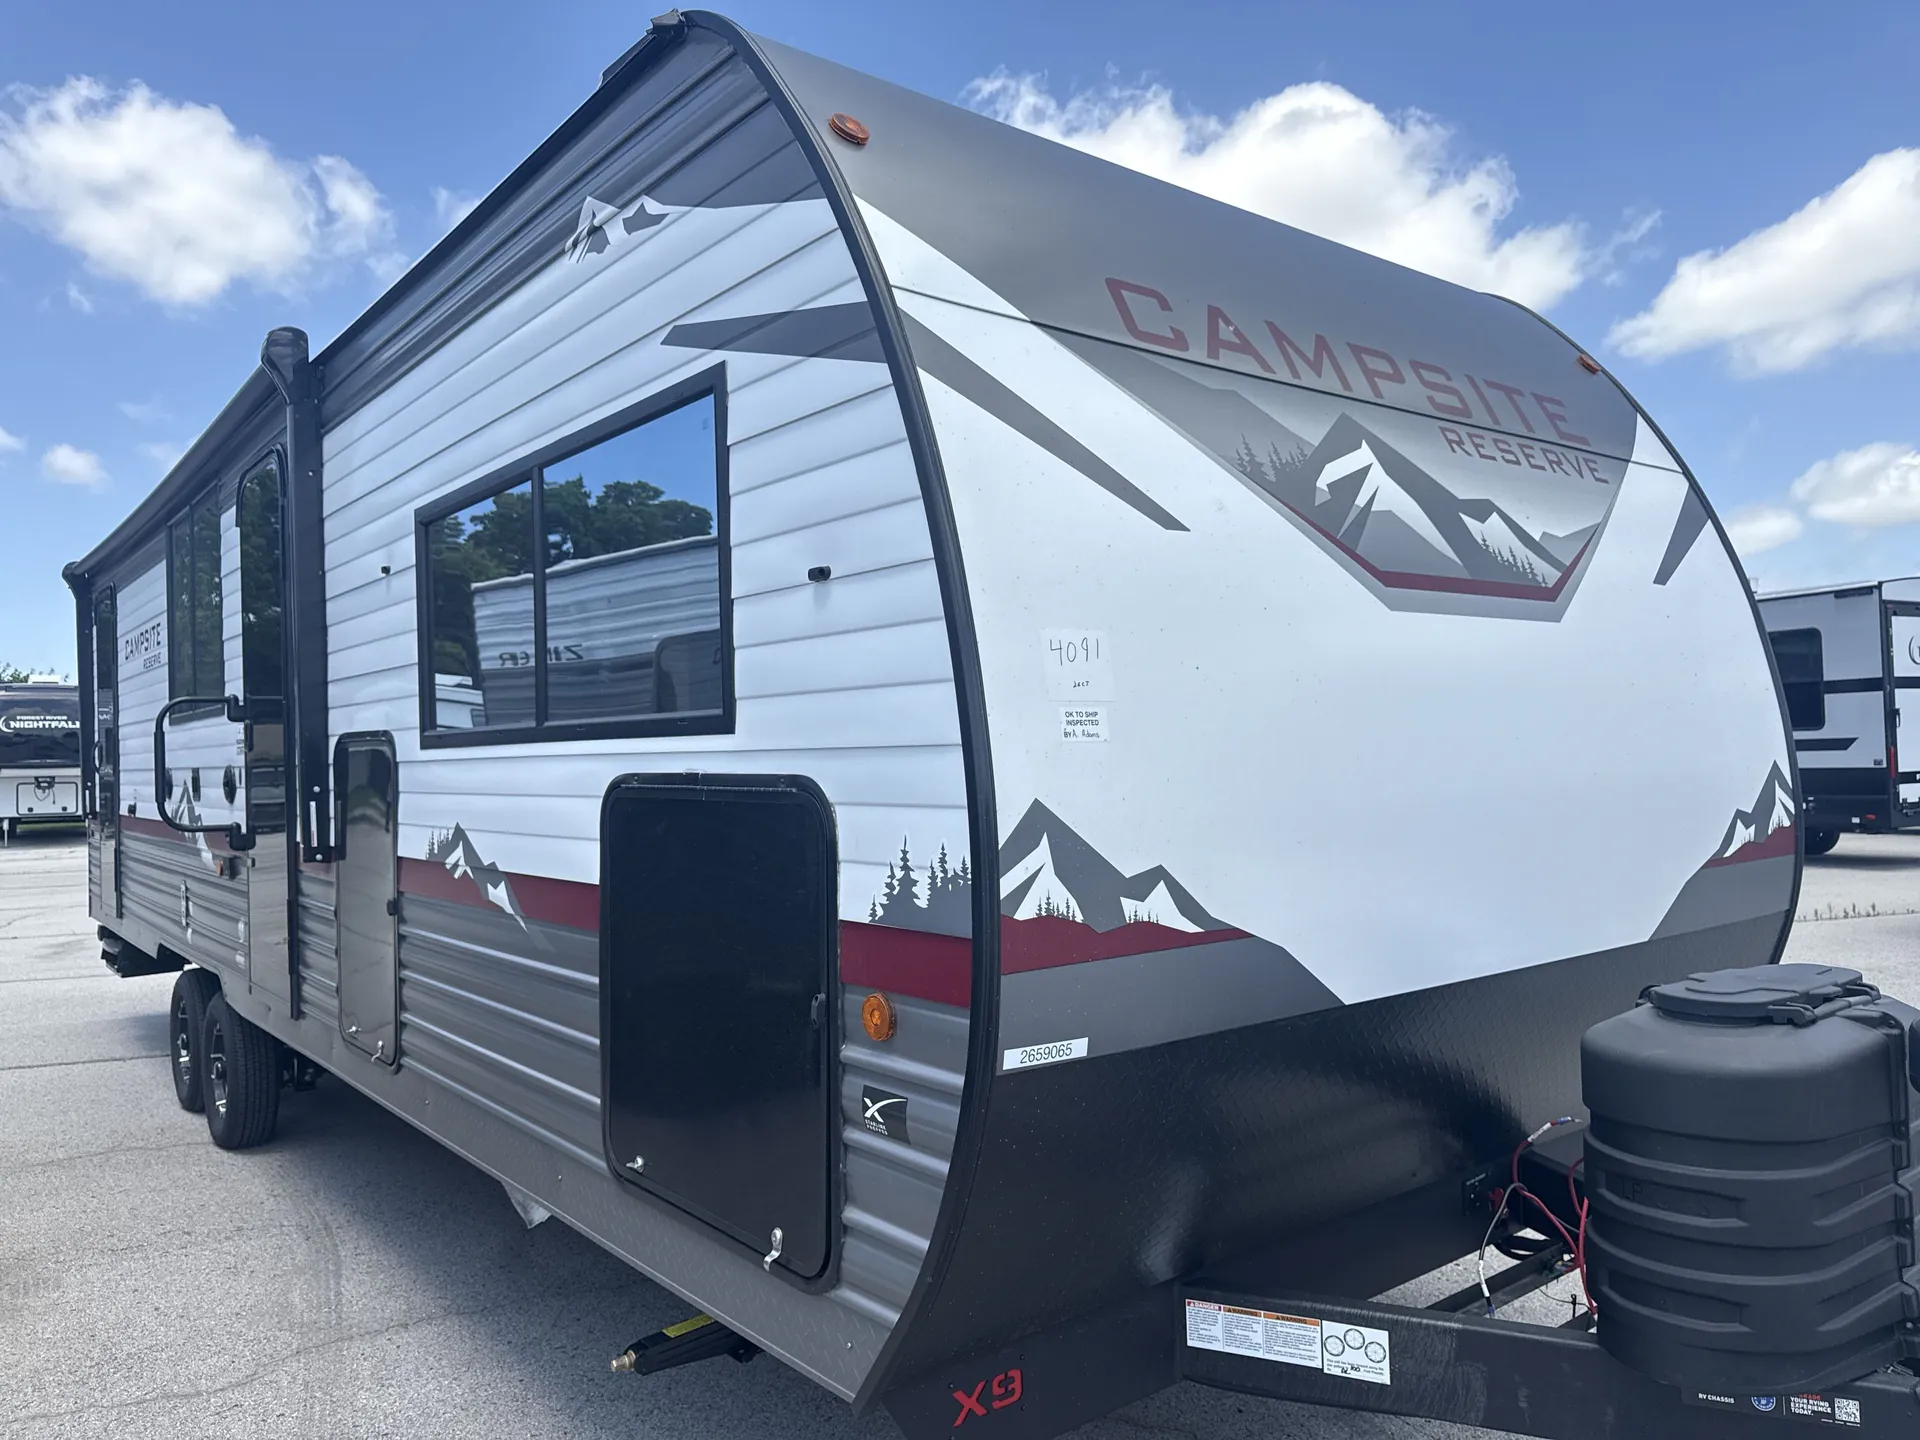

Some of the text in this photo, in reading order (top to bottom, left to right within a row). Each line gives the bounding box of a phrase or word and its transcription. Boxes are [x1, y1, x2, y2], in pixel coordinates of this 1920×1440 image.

[1104, 276, 1592, 447] CAMPSITE
[1437, 425, 1610, 484] RESERVE
[124, 622, 161, 661] CAMPSITE
[143, 651, 162, 670] RESERVE
[1049, 637, 1099, 666] 4091
[1065, 719, 1100, 727] INSPECTED
[1020, 1042, 1073, 1064] 2659065
[1231, 1308, 1258, 1317] WARNING
[1280, 1315, 1307, 1324] WARNING
[951, 1368, 1023, 1428] X9
[1707, 1394, 1735, 1404] CHASSIS
[1790, 1396, 1808, 1405] YOUR
[1790, 1402, 1832, 1414] EXPERIENCE
